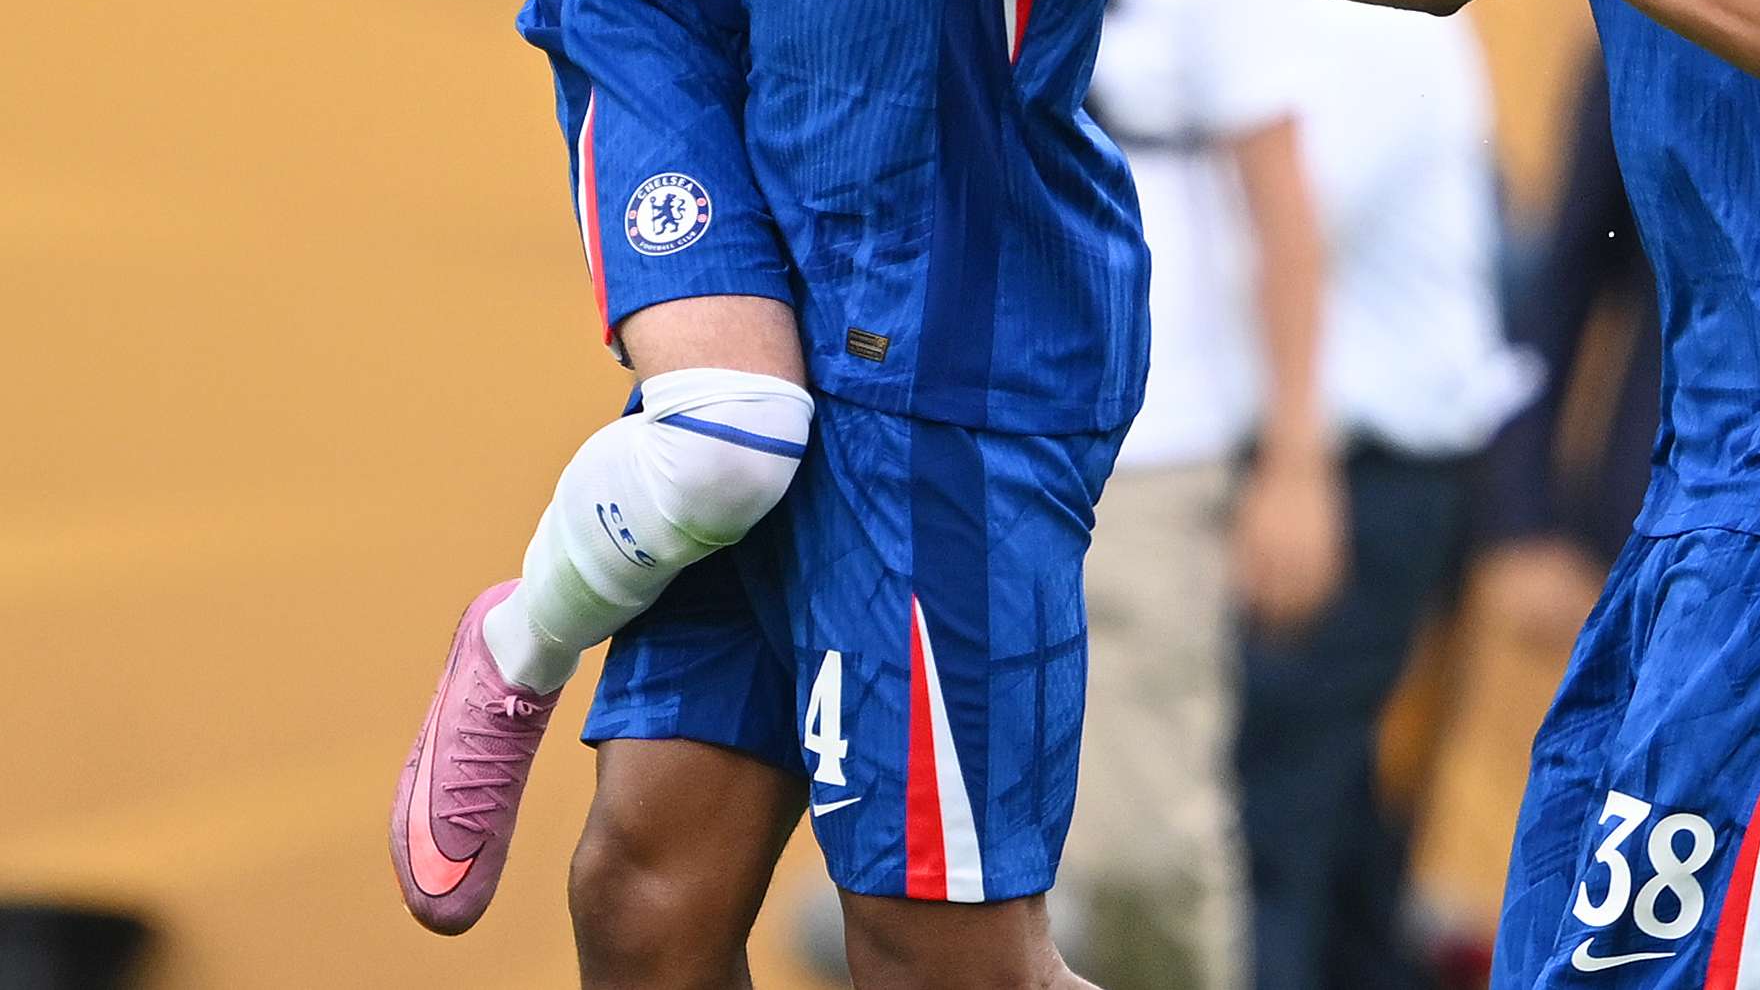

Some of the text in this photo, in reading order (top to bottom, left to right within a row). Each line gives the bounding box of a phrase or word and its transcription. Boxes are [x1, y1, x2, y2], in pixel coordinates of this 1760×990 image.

[637, 176, 693, 199] CHELSEA
[804, 649, 848, 786] 4
[1572, 789, 1716, 940] 38
